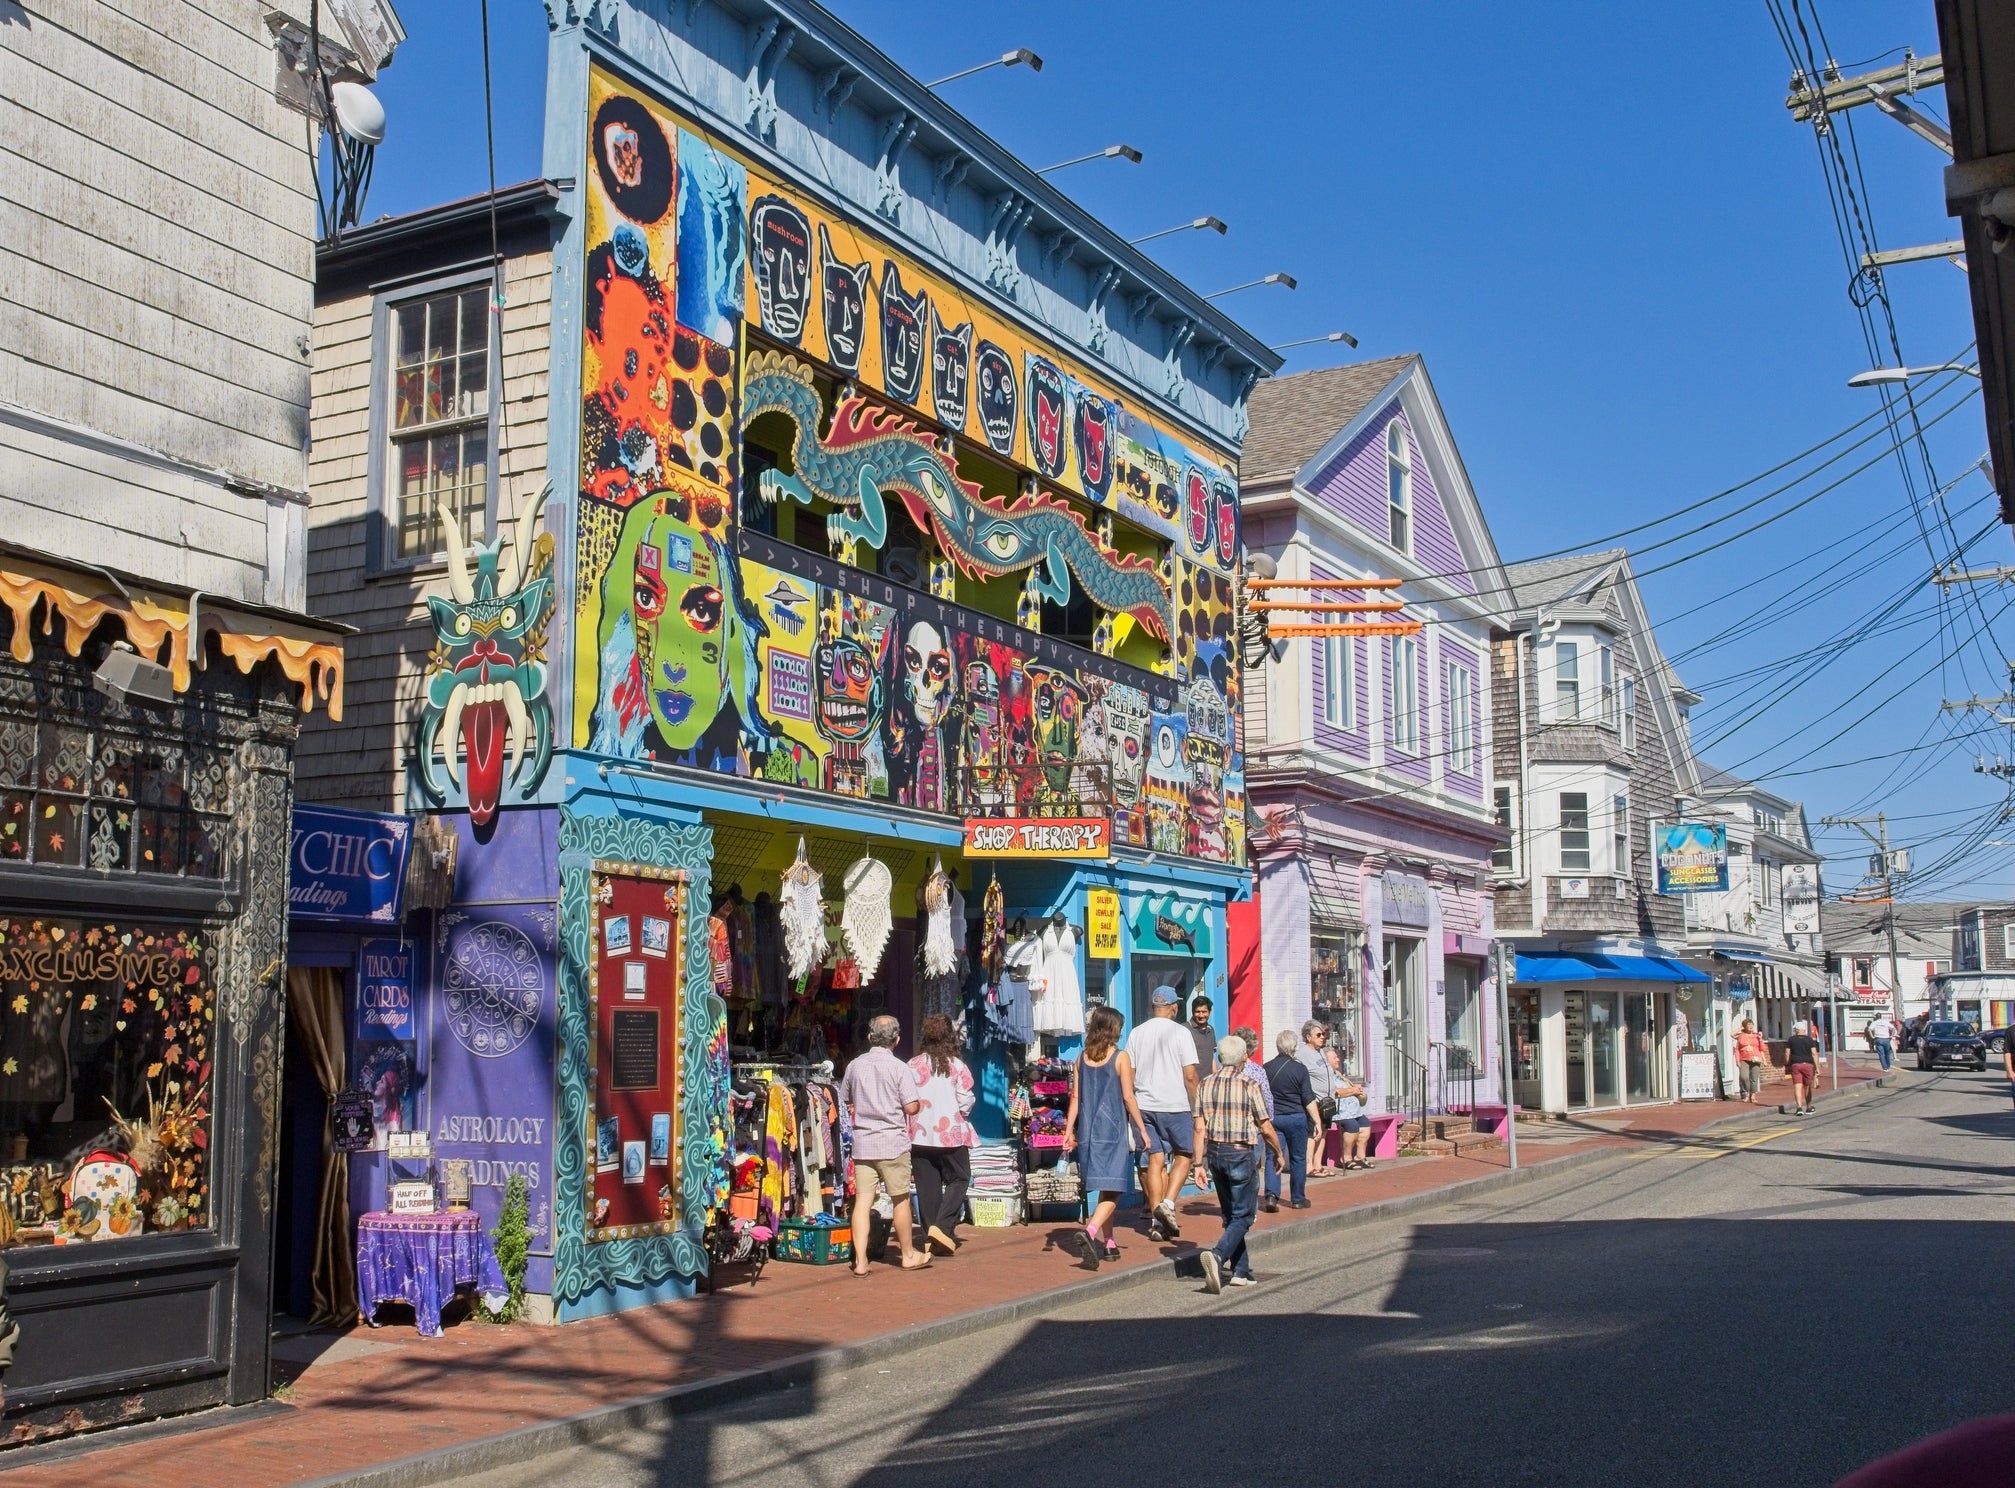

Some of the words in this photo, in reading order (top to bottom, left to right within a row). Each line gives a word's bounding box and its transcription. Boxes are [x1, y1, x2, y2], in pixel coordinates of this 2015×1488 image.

[767, 219, 805, 248] mushroom
[838, 277, 848, 289] pi
[889, 305, 913, 325] orange
[947, 343, 959, 357] cat
[992, 359, 1004, 373] sky
[838, 569, 916, 610] SHOP
[937, 605, 1058, 659] THERAPY
[702, 642, 718, 665] 3
[973, 824, 1016, 850] SHOP
[1019, 824, 1102, 851] THERAPY
[1661, 849, 1725, 867] COCONUTS
[1669, 866, 1717, 876] SUNGLASSES
[1668, 875, 1719, 885] ACCESSORIES
[1096, 895, 1113, 905] SILVER
[1095, 908, 1115, 918] JEWELRY
[1100, 921, 1112, 931] SALE
[365, 955, 408, 978] TAROT
[363, 984, 410, 1009] CARDS
[1087, 992, 1105, 1006] Jewelry
[364, 1008, 409, 1030] Readings
[437, 1114, 545, 1145] ASTROLOGY
[396, 1188, 413, 1198] HALF
[413, 1189, 428, 1198] OFF
[395, 1200, 408, 1209] ALL
